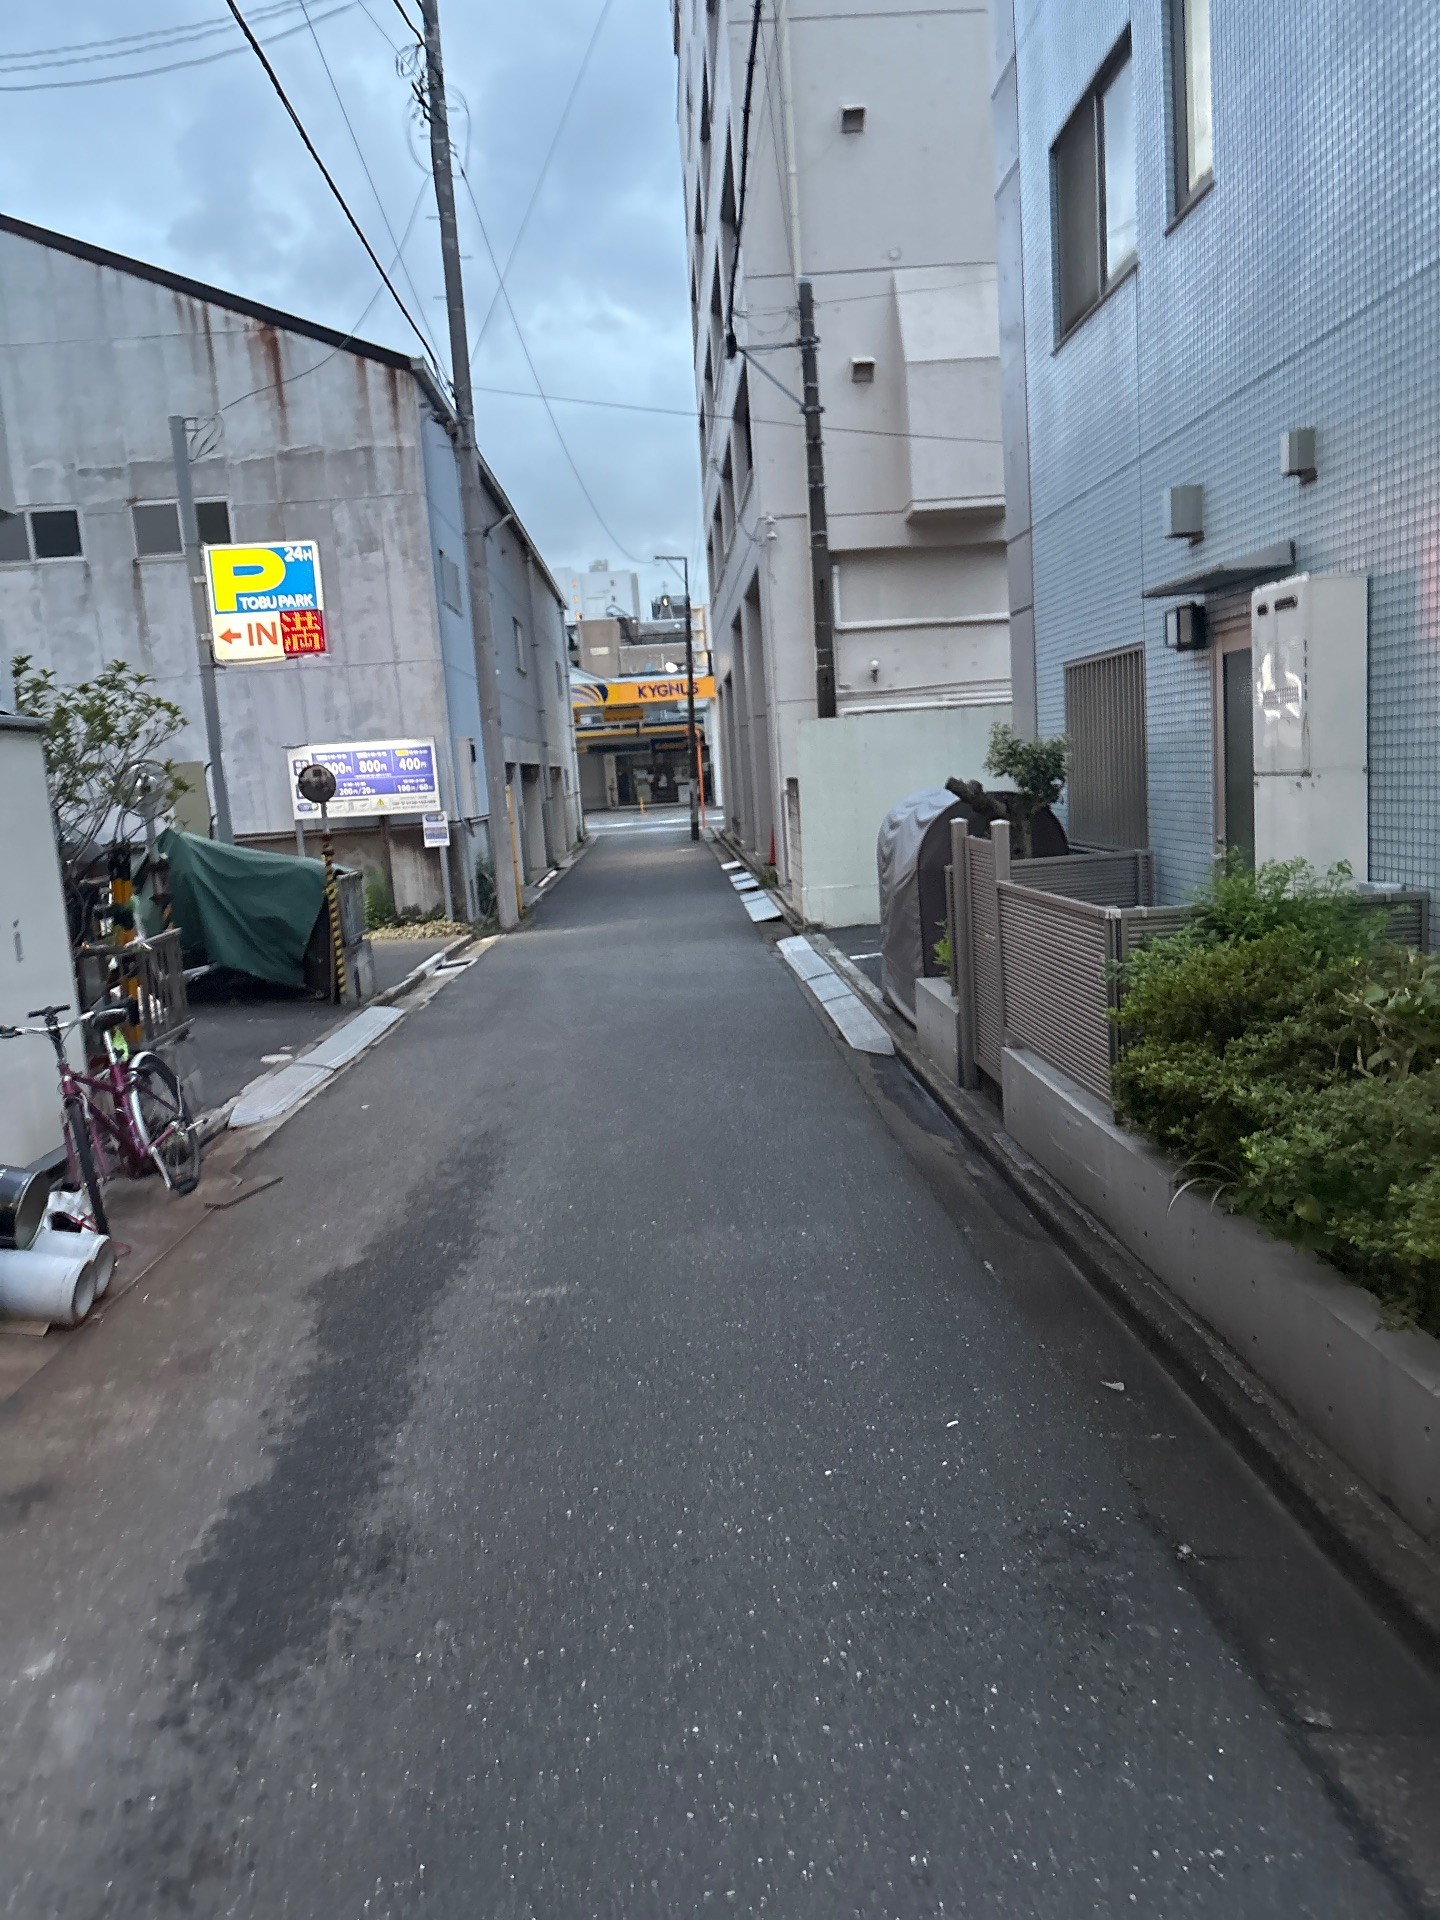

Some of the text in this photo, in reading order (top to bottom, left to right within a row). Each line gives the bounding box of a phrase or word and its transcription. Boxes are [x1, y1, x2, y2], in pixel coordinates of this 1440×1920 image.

[284, 546, 313, 563] 24H
[210, 549, 286, 612] P
[238, 594, 314, 611] TOBU PARK
[246, 621, 278, 647] IN
[281, 610, 323, 652] 満
[637, 681, 698, 699] KYGNUS
